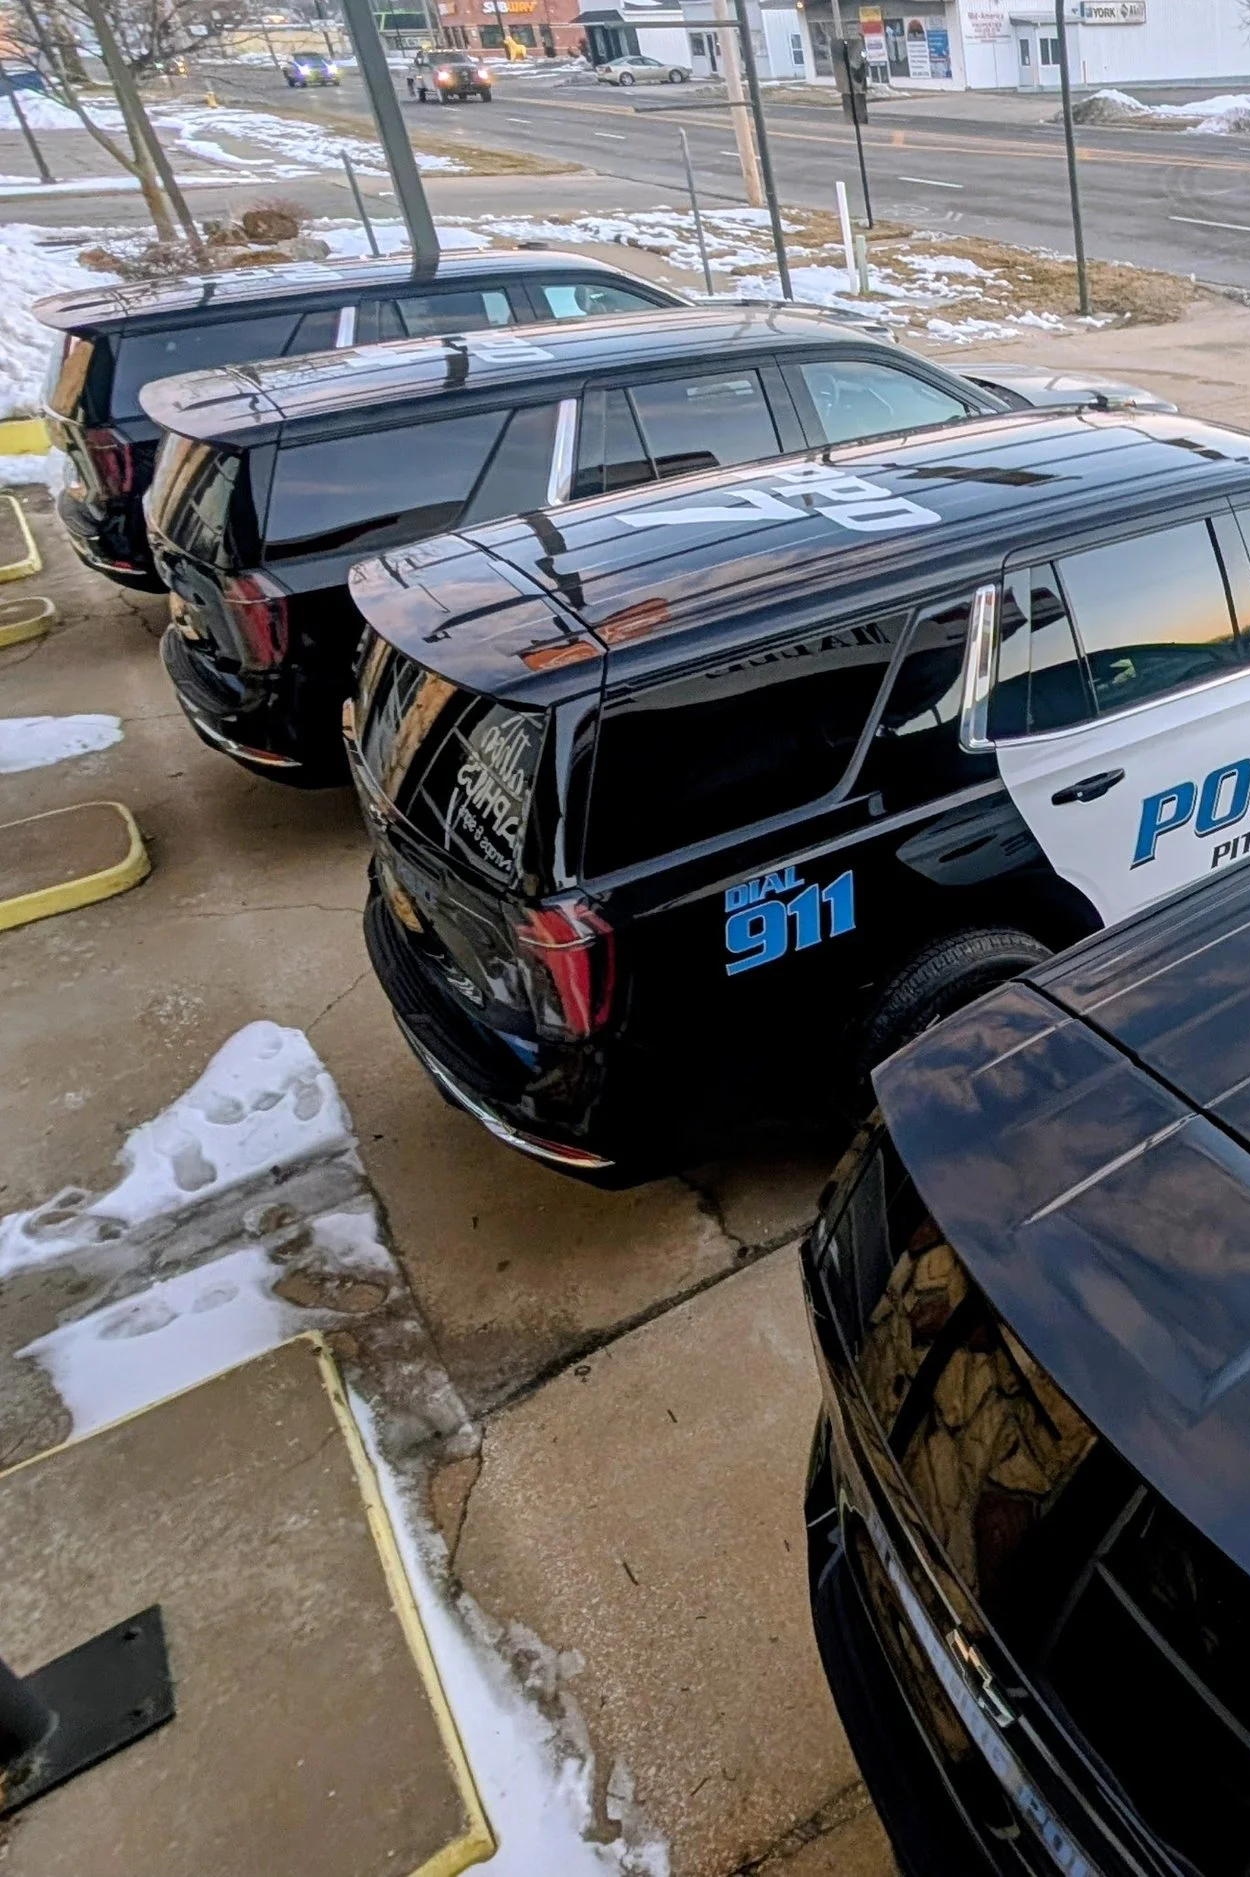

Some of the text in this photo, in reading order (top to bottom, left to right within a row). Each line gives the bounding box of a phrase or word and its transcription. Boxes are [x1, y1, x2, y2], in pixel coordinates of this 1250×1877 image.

[731, 462, 942, 532] PPD
[726, 864, 804, 912] DIAL
[725, 870, 856, 977] 911
